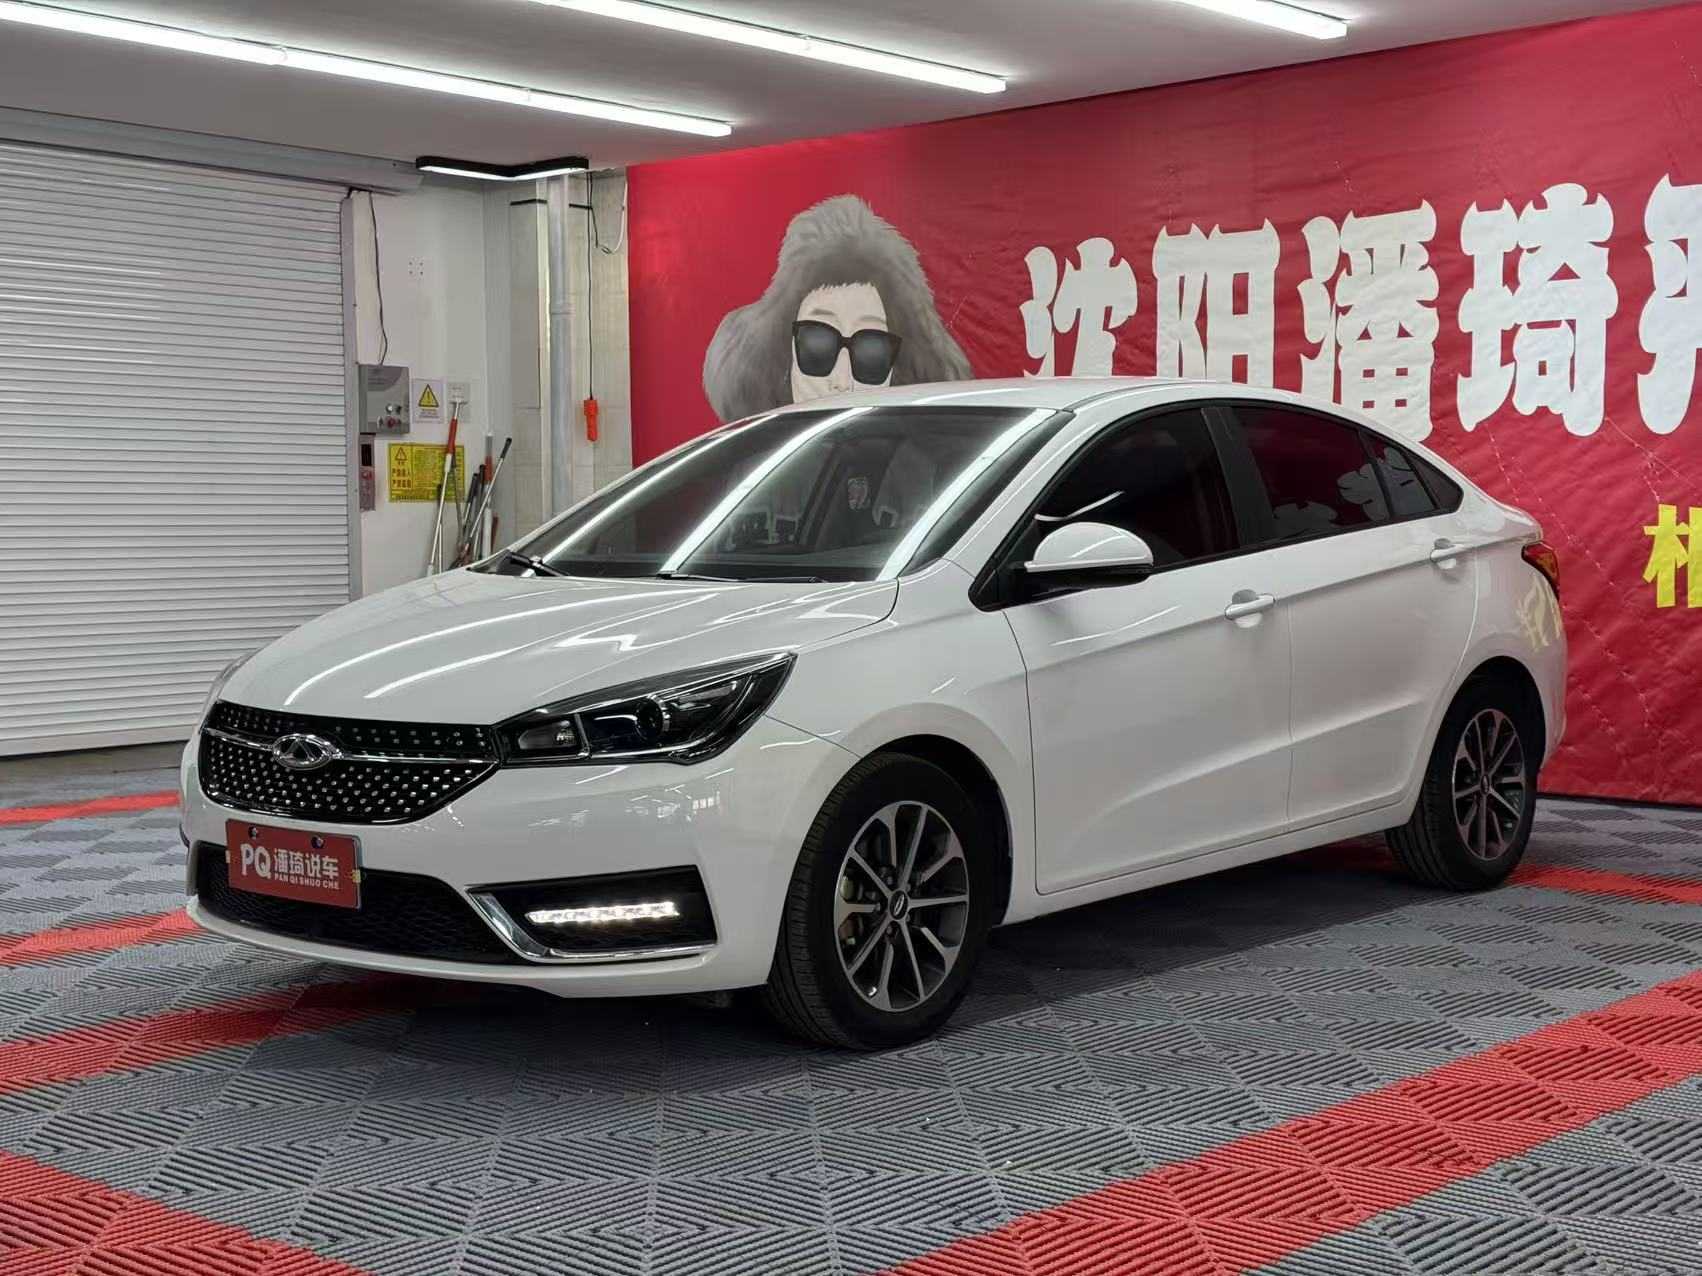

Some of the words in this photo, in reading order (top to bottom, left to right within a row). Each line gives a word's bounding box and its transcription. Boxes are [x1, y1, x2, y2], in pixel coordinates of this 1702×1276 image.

[240, 843, 271, 879] PQ
[273, 847, 339, 879] 潘琦说车
[274, 872, 289, 883] PAN
[289, 876, 298, 885] QI
[322, 880, 341, 890] CHE
